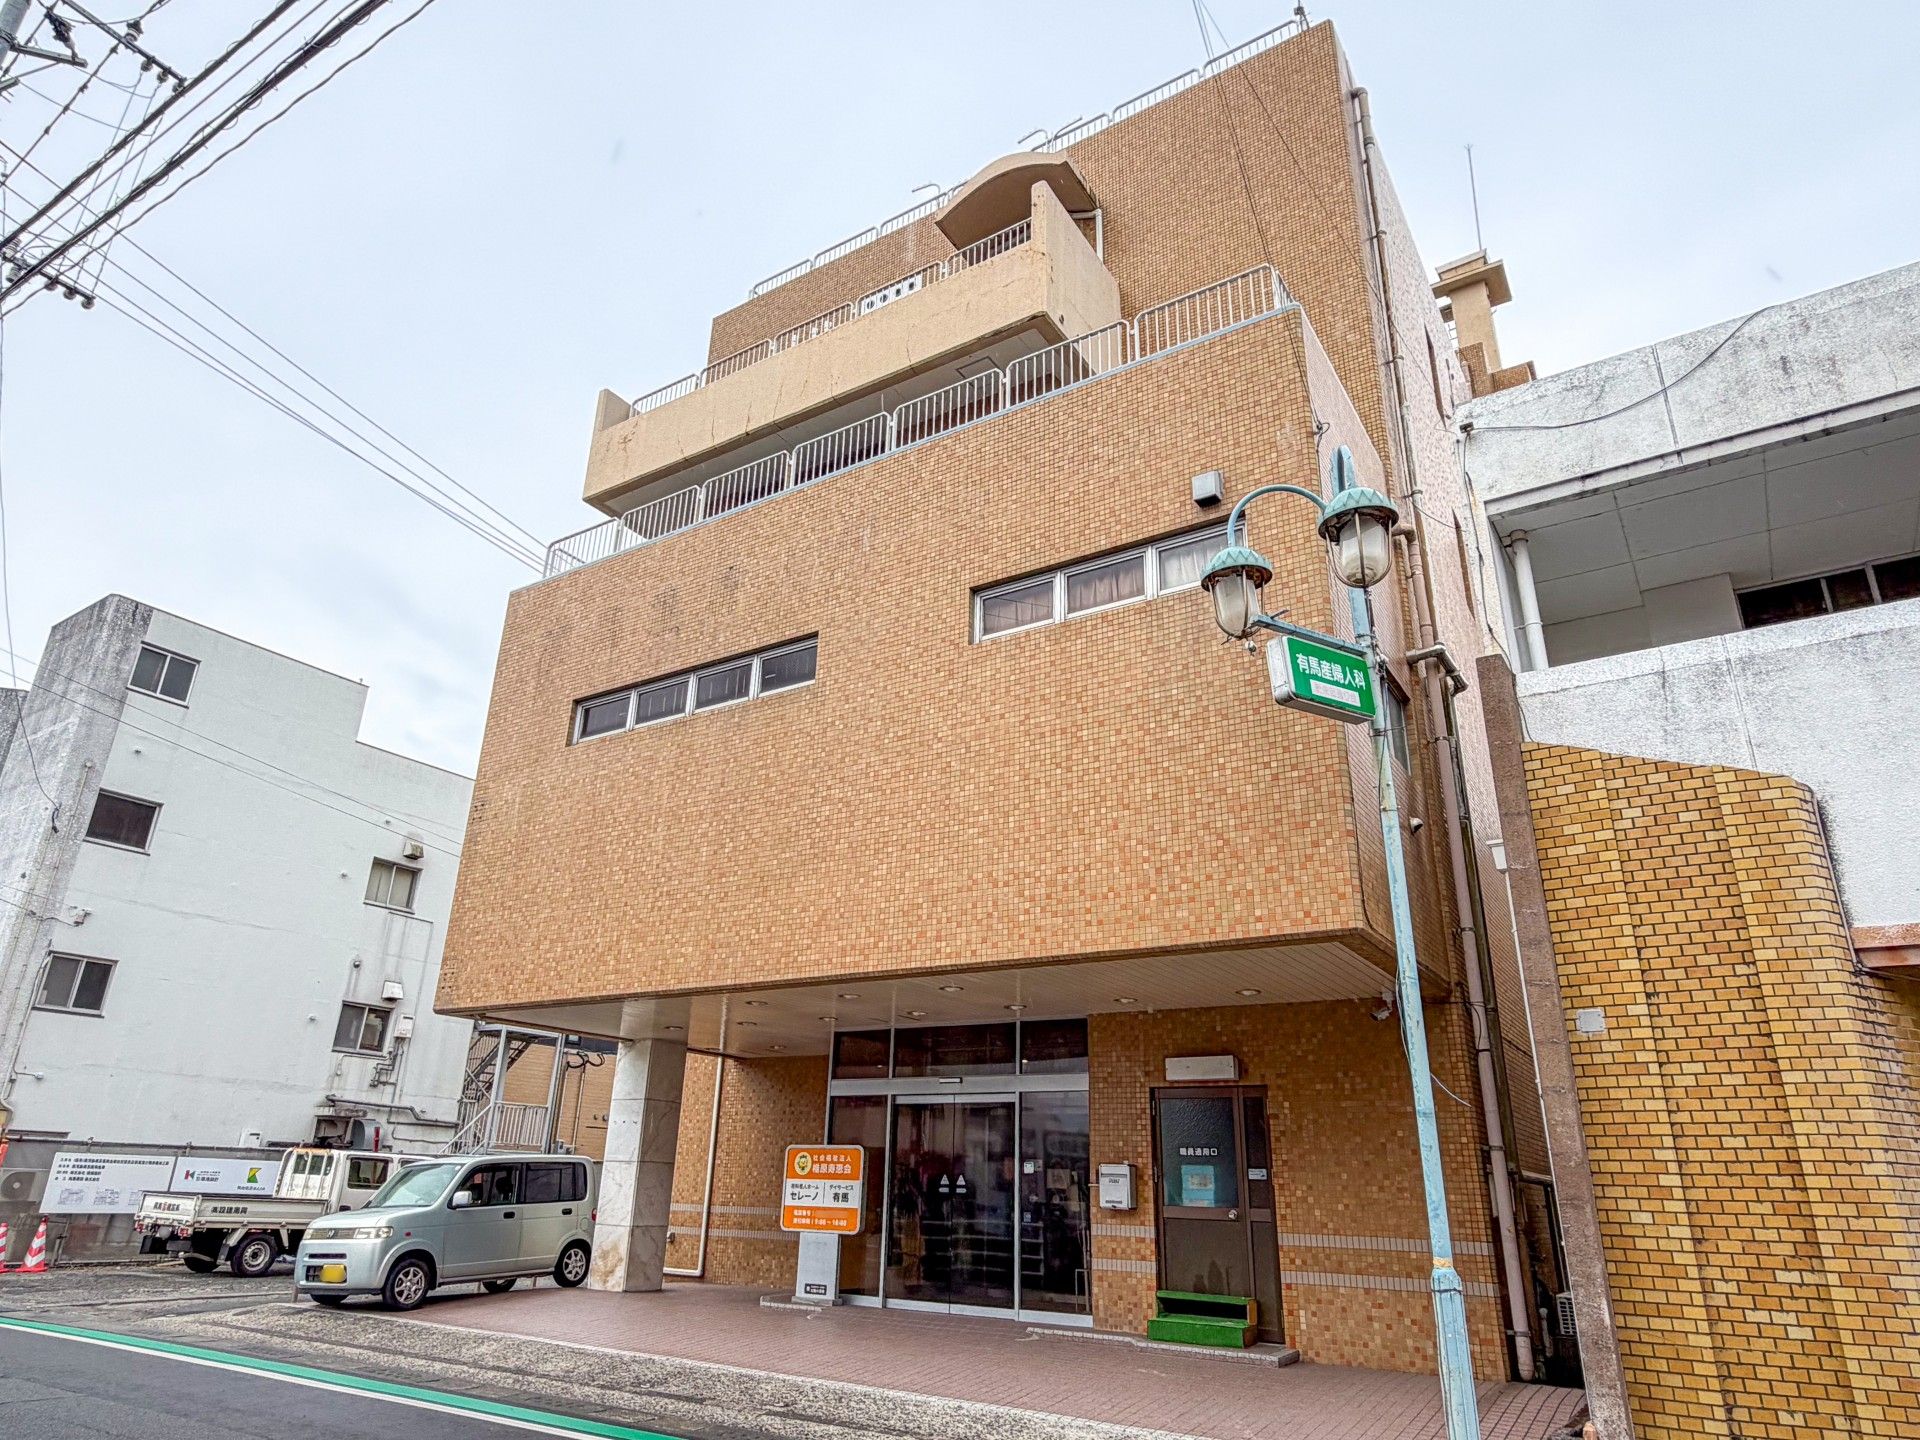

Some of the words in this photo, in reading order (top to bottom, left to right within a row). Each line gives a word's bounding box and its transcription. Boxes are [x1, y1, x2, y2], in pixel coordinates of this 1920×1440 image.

[1295, 652, 1366, 691] 有馬産婦人科
[1179, 1147, 1218, 1156] 職員通用口
[790, 1191, 819, 1201] セレーノ
[832, 1192, 849, 1203] 有馬
